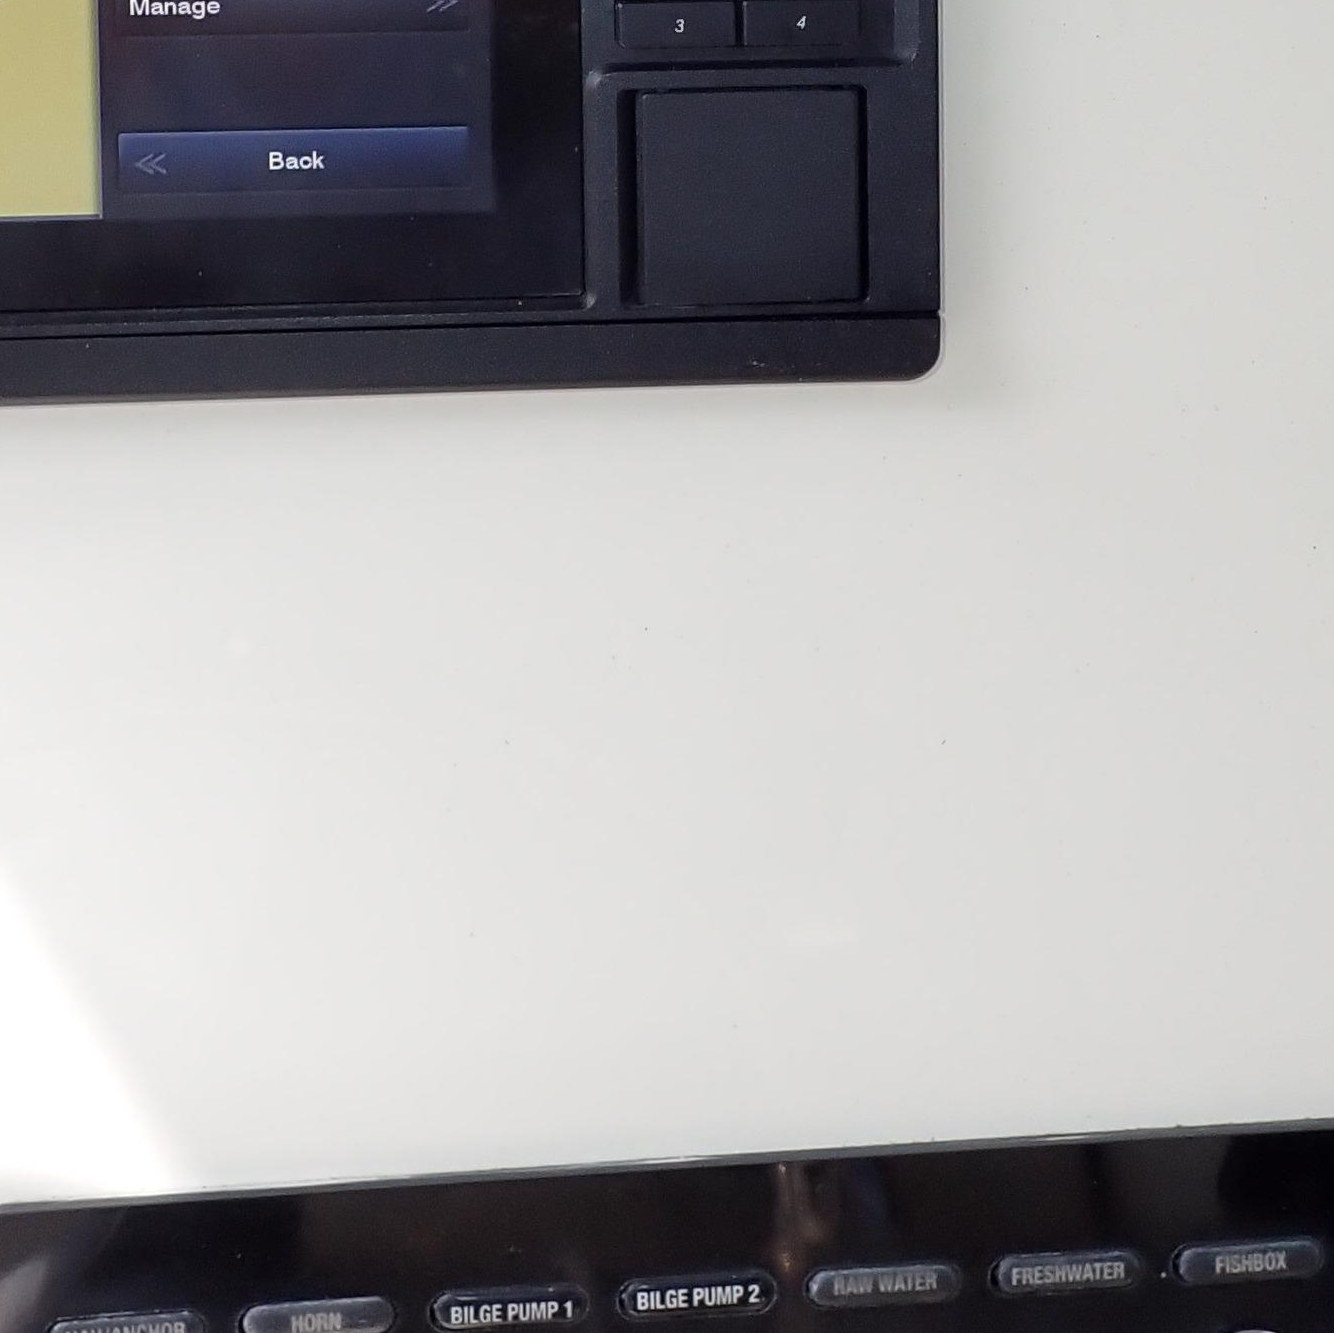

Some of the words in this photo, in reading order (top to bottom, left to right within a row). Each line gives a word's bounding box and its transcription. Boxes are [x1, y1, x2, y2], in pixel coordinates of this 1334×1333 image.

[675, 19, 685, 33] 3
[796, 15, 806, 30] 4
[268, 151, 325, 172] Back
[1216, 1250, 1288, 1274] FISHBOX
[878, 1271, 938, 1293] WATER
[1012, 1262, 1126, 1286] FRESHWATER
[636, 1288, 687, 1311] BILGE
[693, 1285, 744, 1308] PUMP
[748, 1284, 760, 1303] 2
[291, 1312, 342, 1333] HORN
[451, 1304, 502, 1325] BILGE
[507, 1301, 560, 1322] PUMP
[563, 1300, 573, 1319] 1
